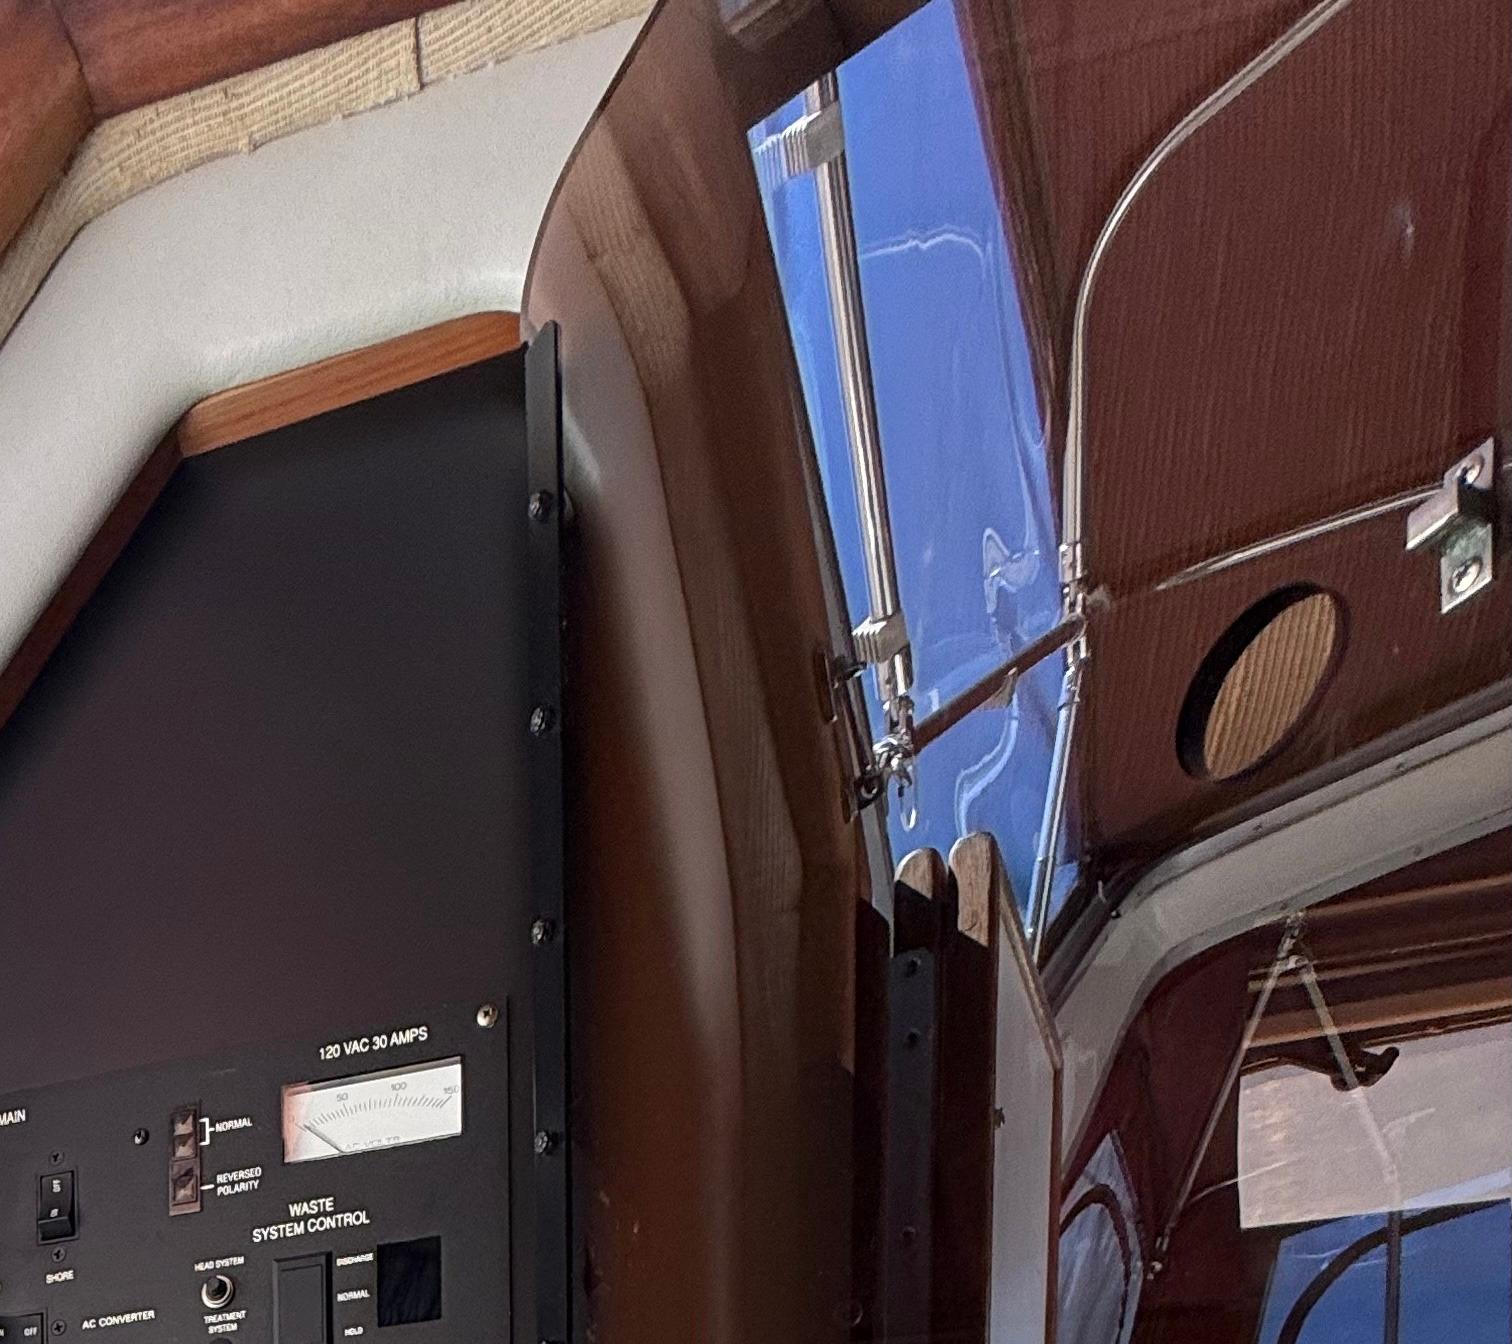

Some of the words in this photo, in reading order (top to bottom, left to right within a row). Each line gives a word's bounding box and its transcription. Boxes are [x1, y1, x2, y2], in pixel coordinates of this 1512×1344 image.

[319, 1044, 341, 1060] 120
[343, 1038, 369, 1056] VAC
[372, 1035, 388, 1050] 30
[390, 1026, 428, 1047] AMPS
[215, 1117, 252, 1133] NORMAL
[217, 1167, 262, 1184] REVERSED
[217, 1180, 260, 1196] POLARITY
[289, 1197, 334, 1218] WASTE
[252, 1221, 305, 1243] SYSTEM
[307, 1210, 370, 1233] CONTROL
[194, 1260, 215, 1272] HEAD
[215, 1256, 245, 1268] SYSTEM
[46, 1270, 74, 1284] SHORE
[337, 1289, 370, 1302] NORMAL
[82, 1319, 97, 1331] AC
[99, 1309, 155, 1328] CONVERTER
[204, 1310, 247, 1324] TREATMENT
[23, 1326, 38, 1337] OFF
[208, 1323, 238, 1334] SYSTEM
[344, 1326, 364, 1337] HOLD
